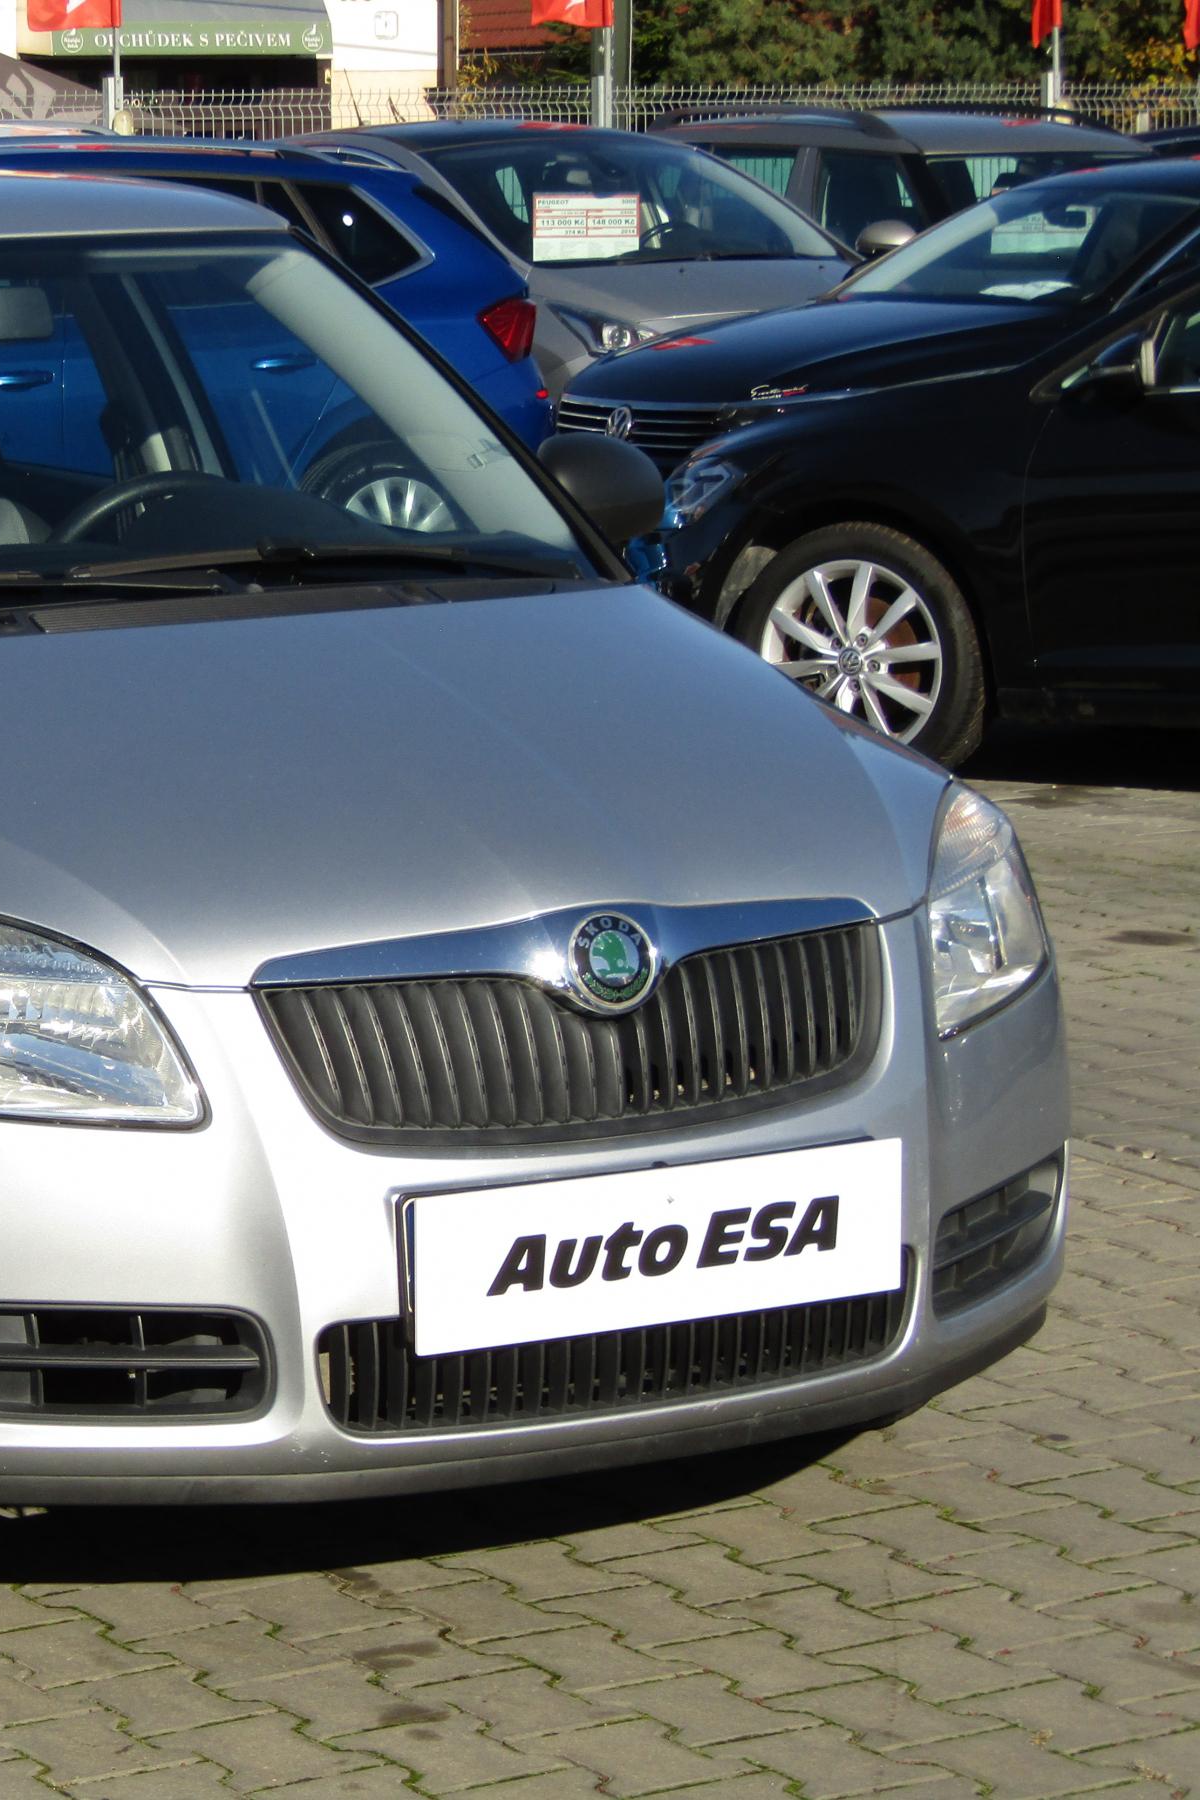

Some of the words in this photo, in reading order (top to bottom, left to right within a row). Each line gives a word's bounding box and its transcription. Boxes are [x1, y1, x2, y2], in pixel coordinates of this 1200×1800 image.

[199, 32, 209, 47] S
[215, 30, 291, 47] PEČIVEM
[486, 1221, 688, 1297] Auto
[696, 1194, 840, 1269] ESA
